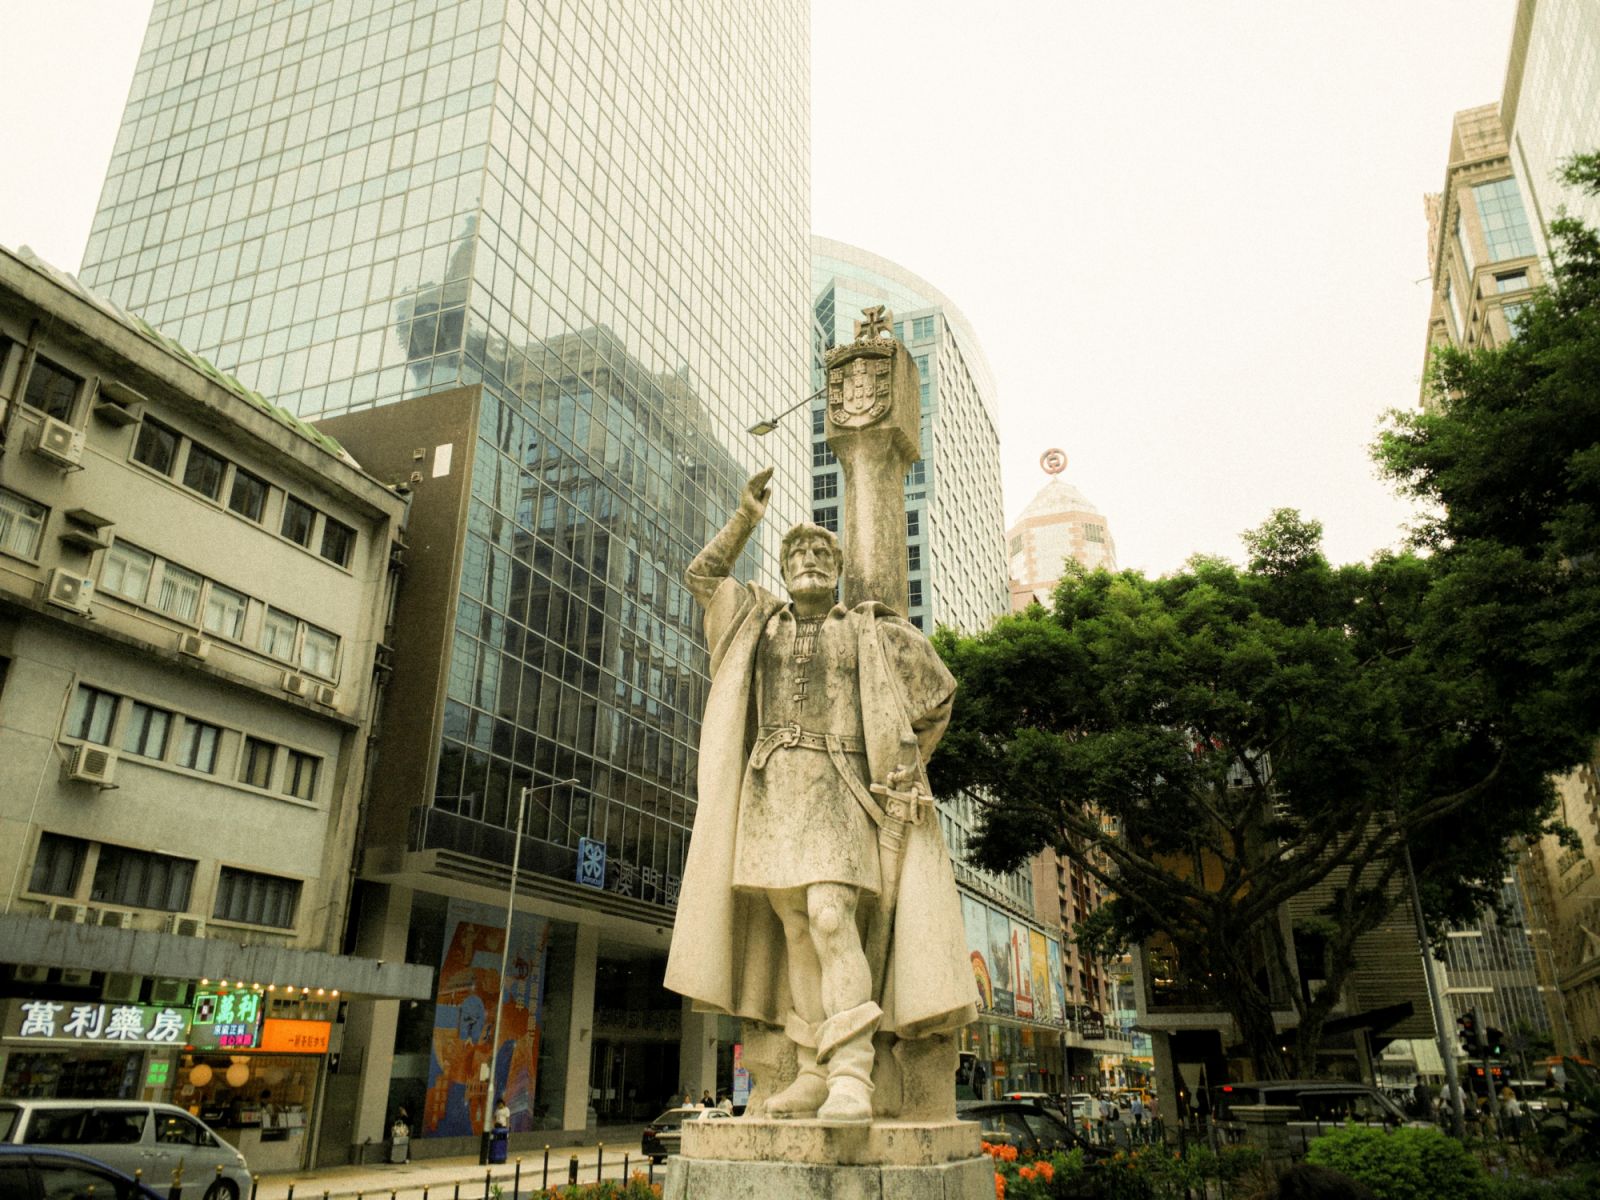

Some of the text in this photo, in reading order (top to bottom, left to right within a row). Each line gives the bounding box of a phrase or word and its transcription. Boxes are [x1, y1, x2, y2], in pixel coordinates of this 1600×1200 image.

[20, 1001, 184, 1042] 萬利藥房
[216, 994, 259, 1024] 萬利
